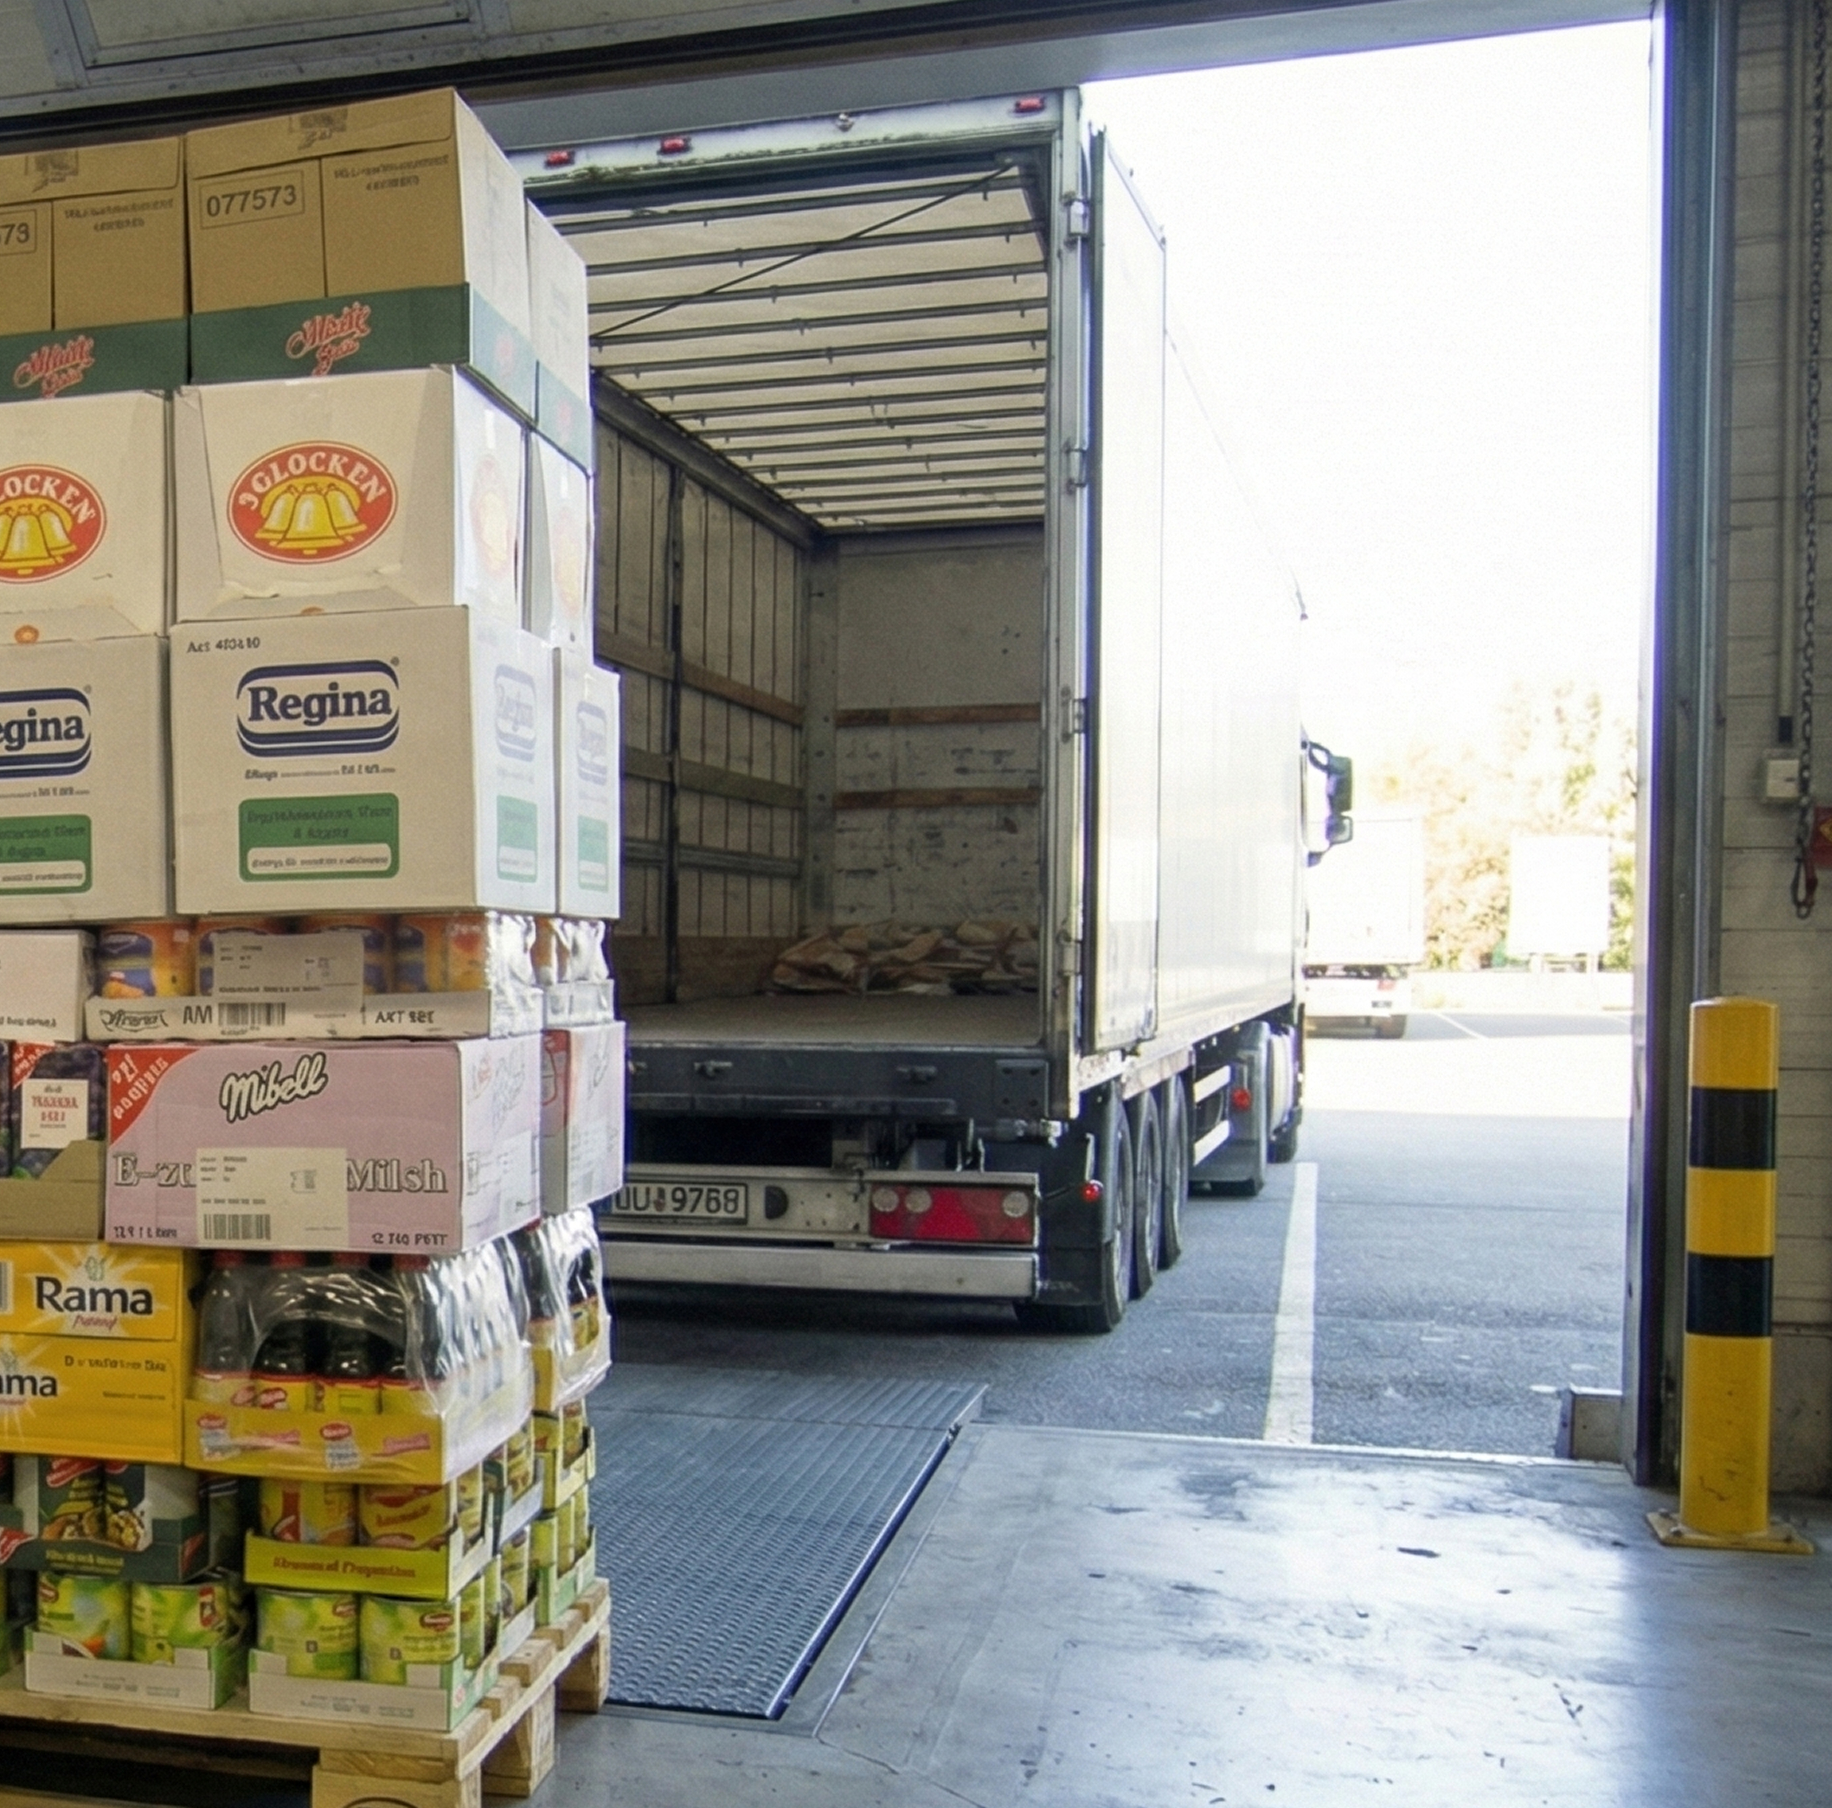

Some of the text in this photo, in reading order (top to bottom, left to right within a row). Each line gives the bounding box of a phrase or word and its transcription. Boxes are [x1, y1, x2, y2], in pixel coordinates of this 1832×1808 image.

[206, 184, 297, 218] 077573
[247, 682, 393, 727] Regina
[219, 1051, 329, 1124] Mibell
[35, 1275, 154, 1316] Rama
